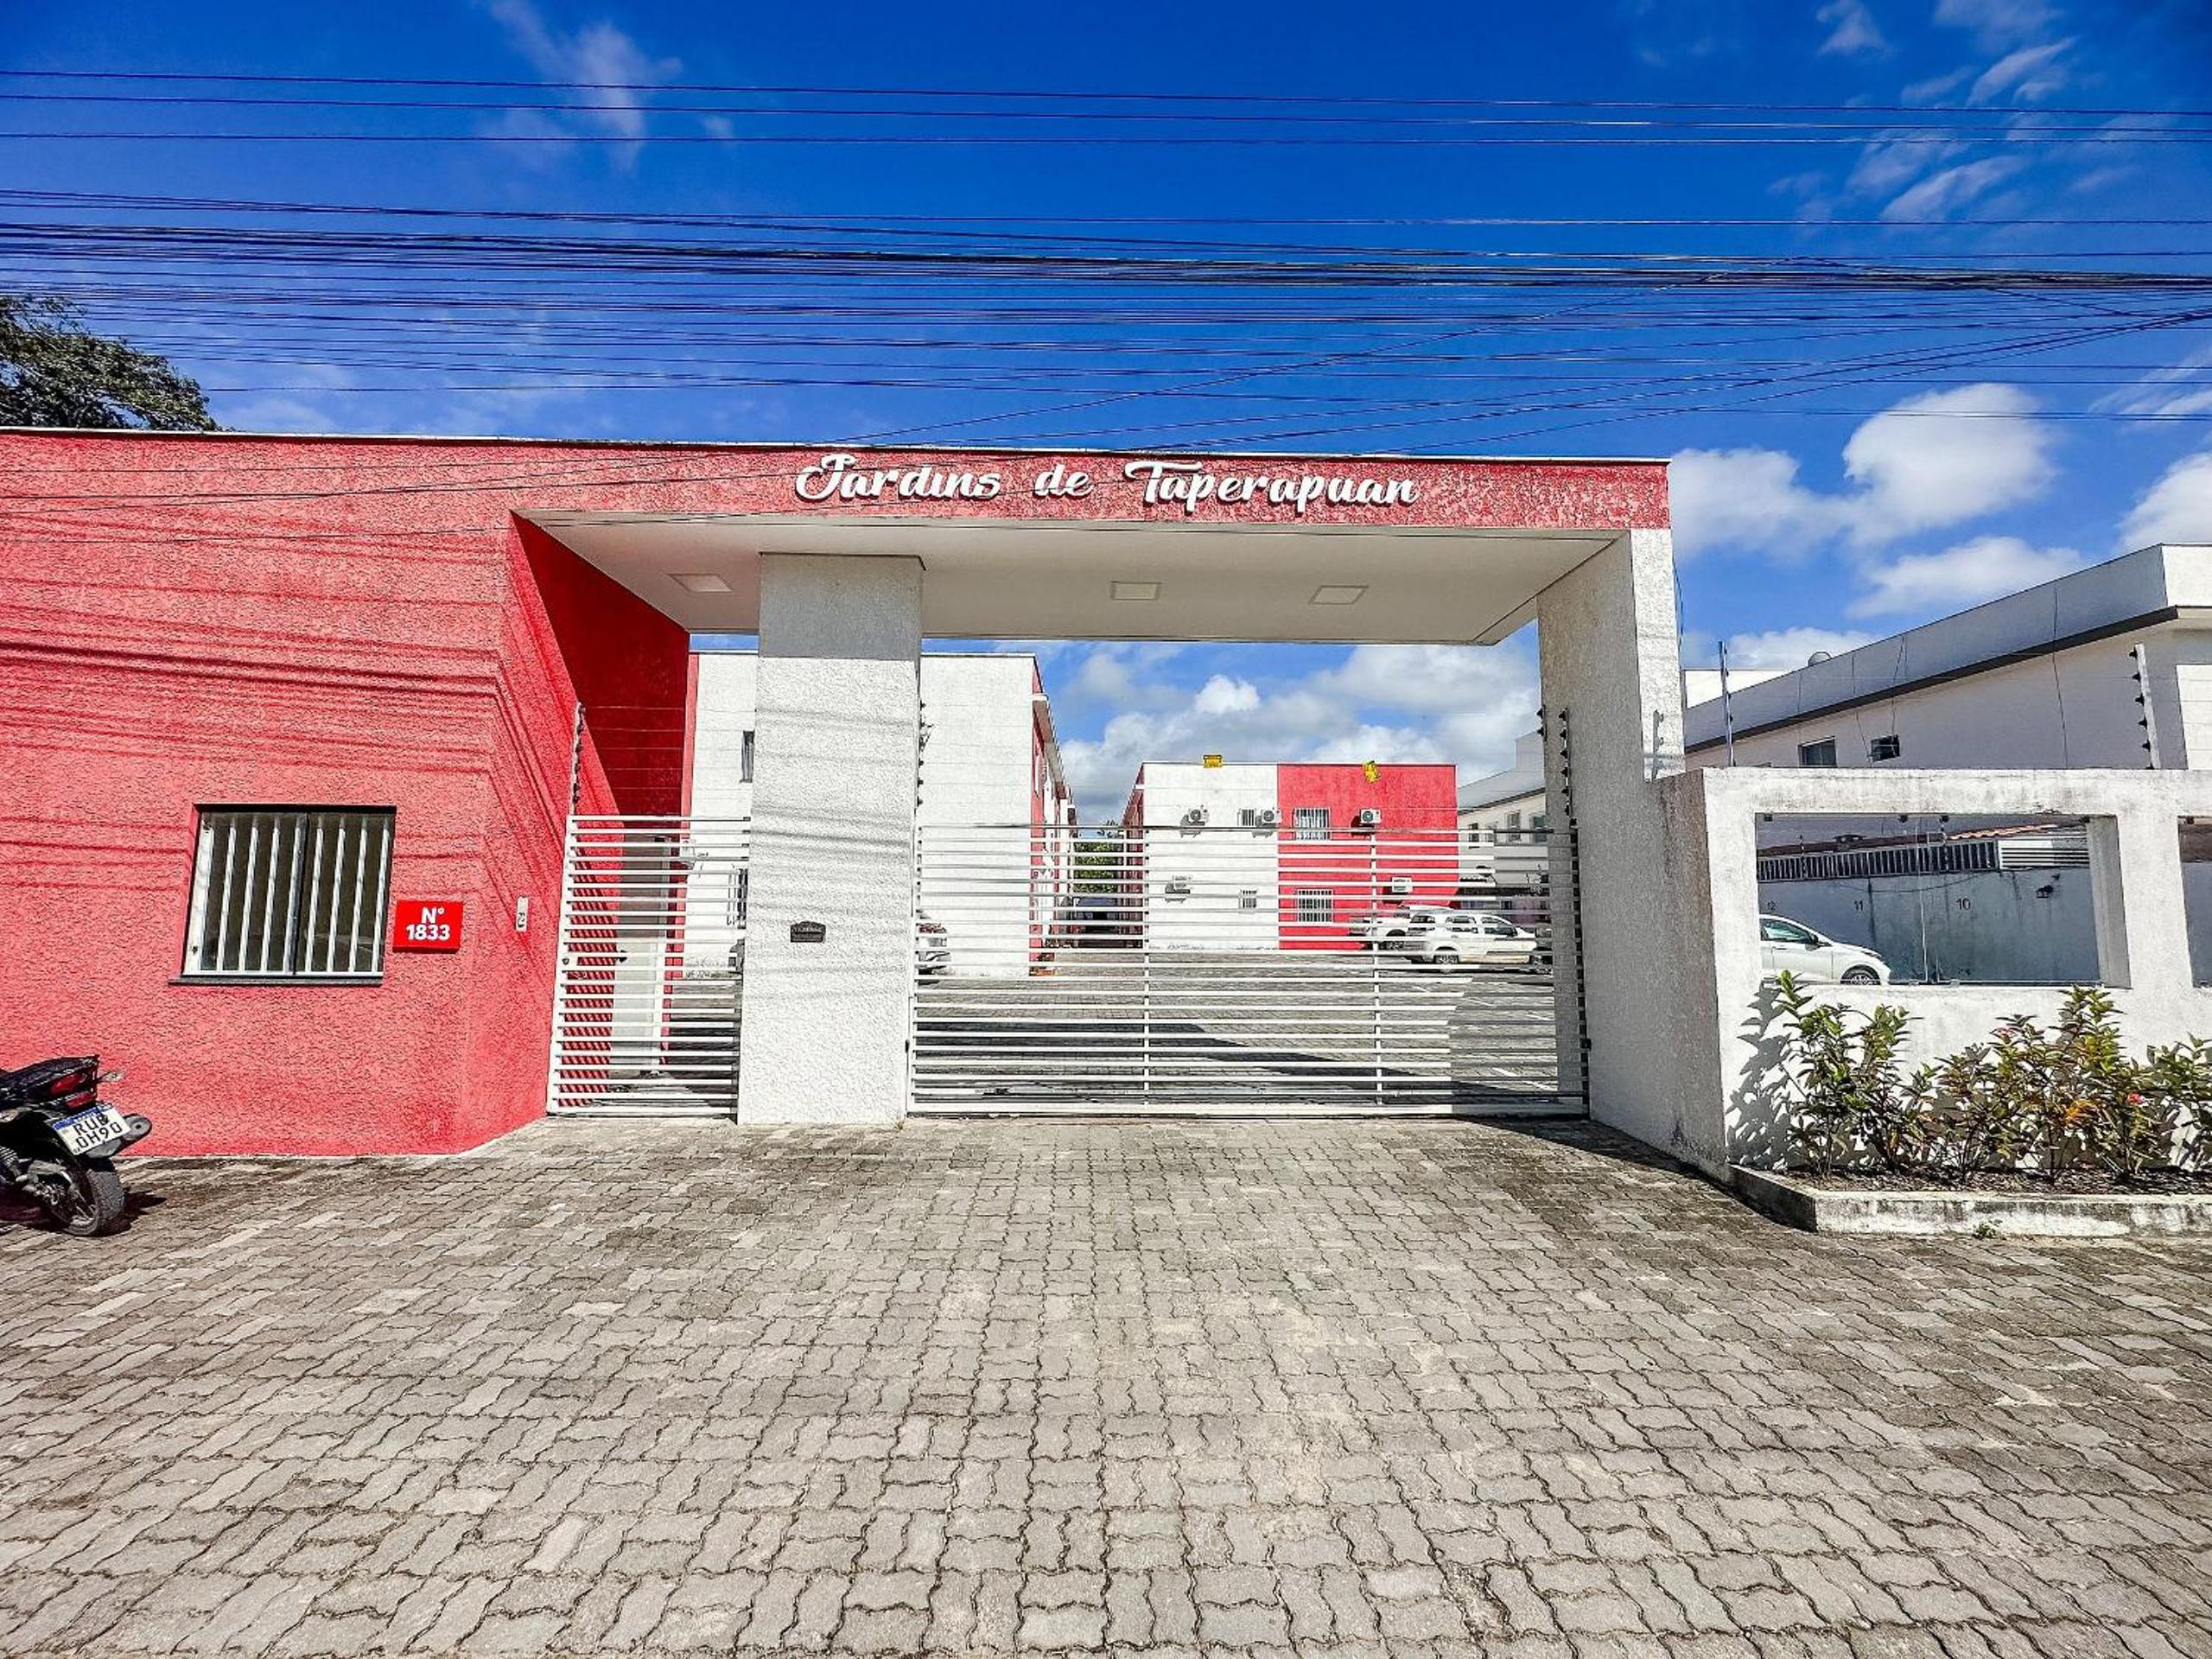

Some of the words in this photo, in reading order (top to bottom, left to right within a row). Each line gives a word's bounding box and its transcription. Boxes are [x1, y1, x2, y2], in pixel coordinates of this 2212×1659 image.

[795, 454, 1001, 499] Jardins
[1034, 463, 1095, 496] de
[1124, 461, 1420, 513] Taperapuan
[1854, 900, 1863, 911] 11
[1956, 898, 1970, 910] 10
[406, 924, 450, 940] 1833
